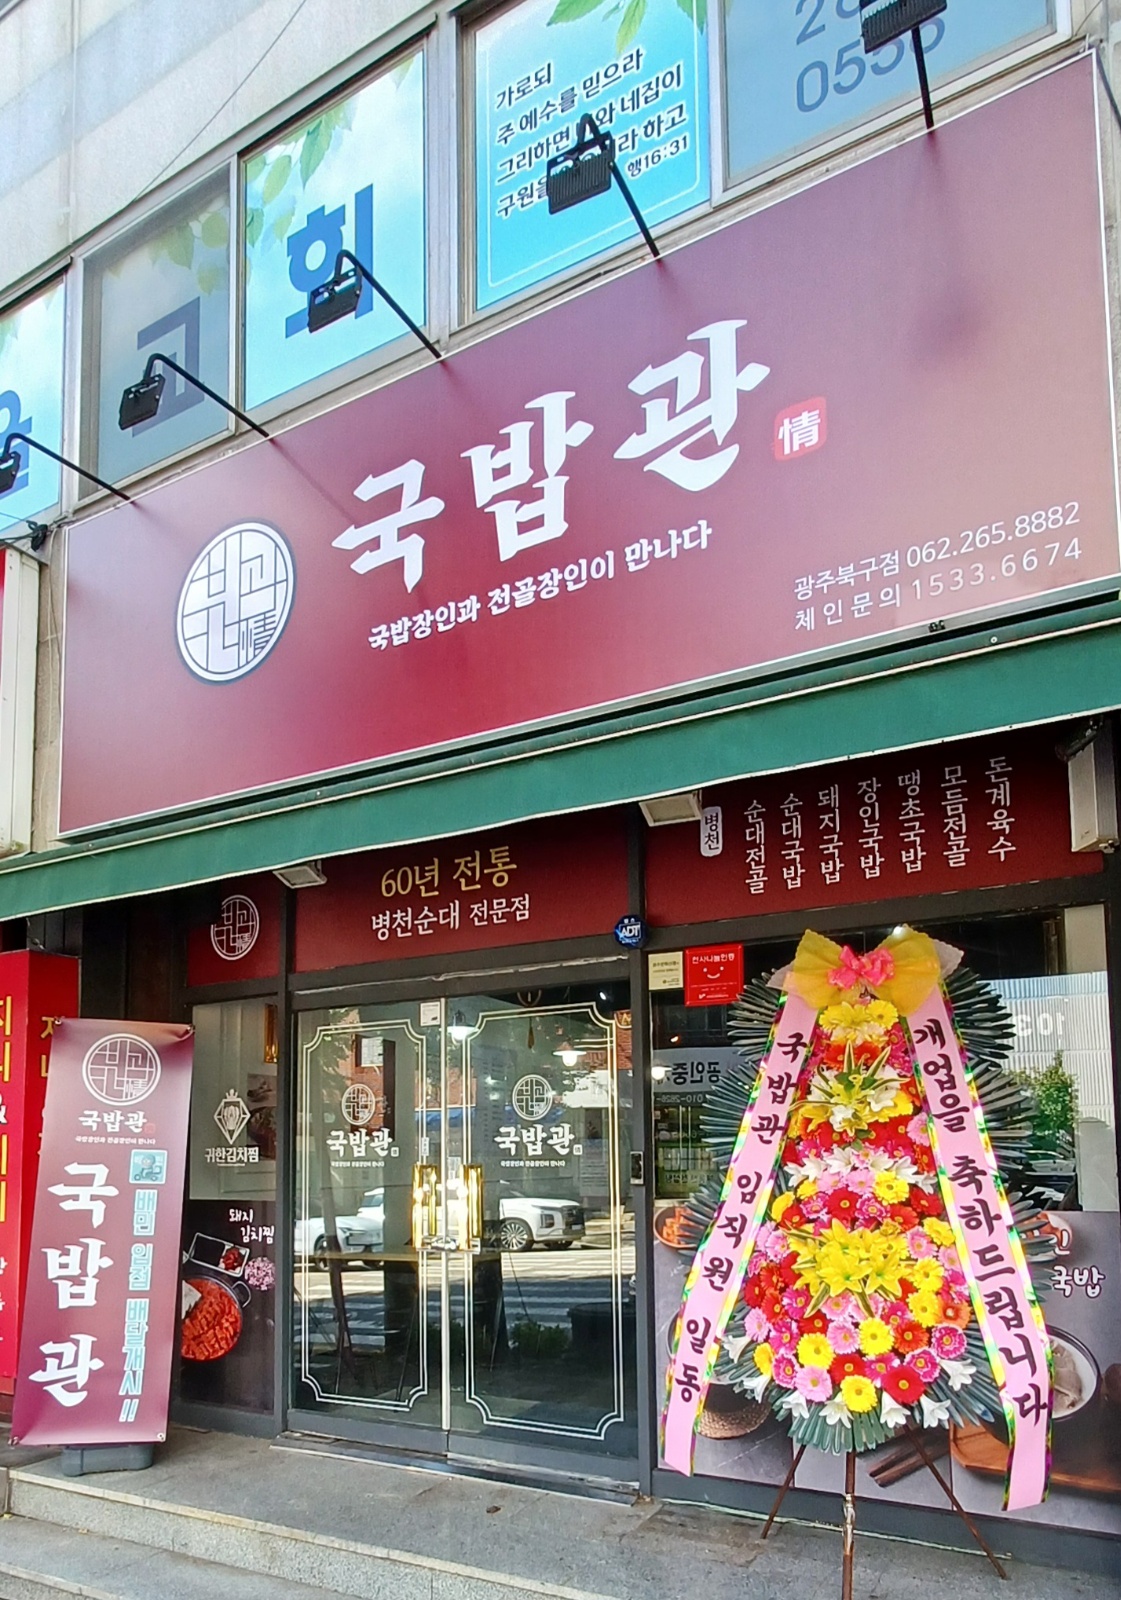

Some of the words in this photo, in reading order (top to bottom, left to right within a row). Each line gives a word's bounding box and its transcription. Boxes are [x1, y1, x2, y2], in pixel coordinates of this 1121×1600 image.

[496, 62, 551, 109] 가로되
[497, 123, 515, 145] 주
[519, 86, 577, 131] 예수를
[583, 48, 643, 98] 믿으라
[497, 127, 570, 183] 그리하면
[621, 64, 681, 113] 네집이
[643, 104, 687, 138] 하고
[628, 135, 687, 177] 행16:31
[331, 319, 771, 593] 국밥관
[778, 410, 821, 455] 情
[367, 596, 481, 650] 국밥장인과
[486, 549, 616, 618] 전골장인이
[623, 519, 713, 573] 만나다
[793, 550, 900, 600] 광주북구점
[906, 501, 1080, 567] 062.265.8882
[703, 813, 720, 851] 병천
[743, 799, 768, 894] 순대전골
[779, 793, 806, 889] 순대국밥
[818, 784, 844, 885] 돼지국밥
[857, 777, 885, 879] 장인국밥
[898, 769, 926, 873] 땡초국밥
[940, 765, 970, 867] 모듬전골
[985, 756, 1016, 862] 돈계육수
[381, 857, 439, 898] 60년
[452, 845, 518, 892] 전통
[370, 899, 461, 941] 병천순대
[469, 893, 531, 926] 전문점
[621, 924, 641, 937] ADT
[751, 1032, 806, 1144] 국밥관
[914, 1018, 970, 1132] 개업을
[78, 1110, 147, 1133] 국밥관
[204, 1146, 259, 1163] 귀한김치찜
[326, 1127, 393, 1157] 국밥관
[494, 1123, 575, 1156] 국밥관
[229, 1208, 254, 1223] 돼지
[241, 1225, 275, 1244] 김치찜
[703, 1171, 762, 1292] 임직원
[29, 1162, 119, 1407] 국밥관
[1050, 1264, 1106, 1298] 국밥
[675, 1317, 711, 1402] 일동
